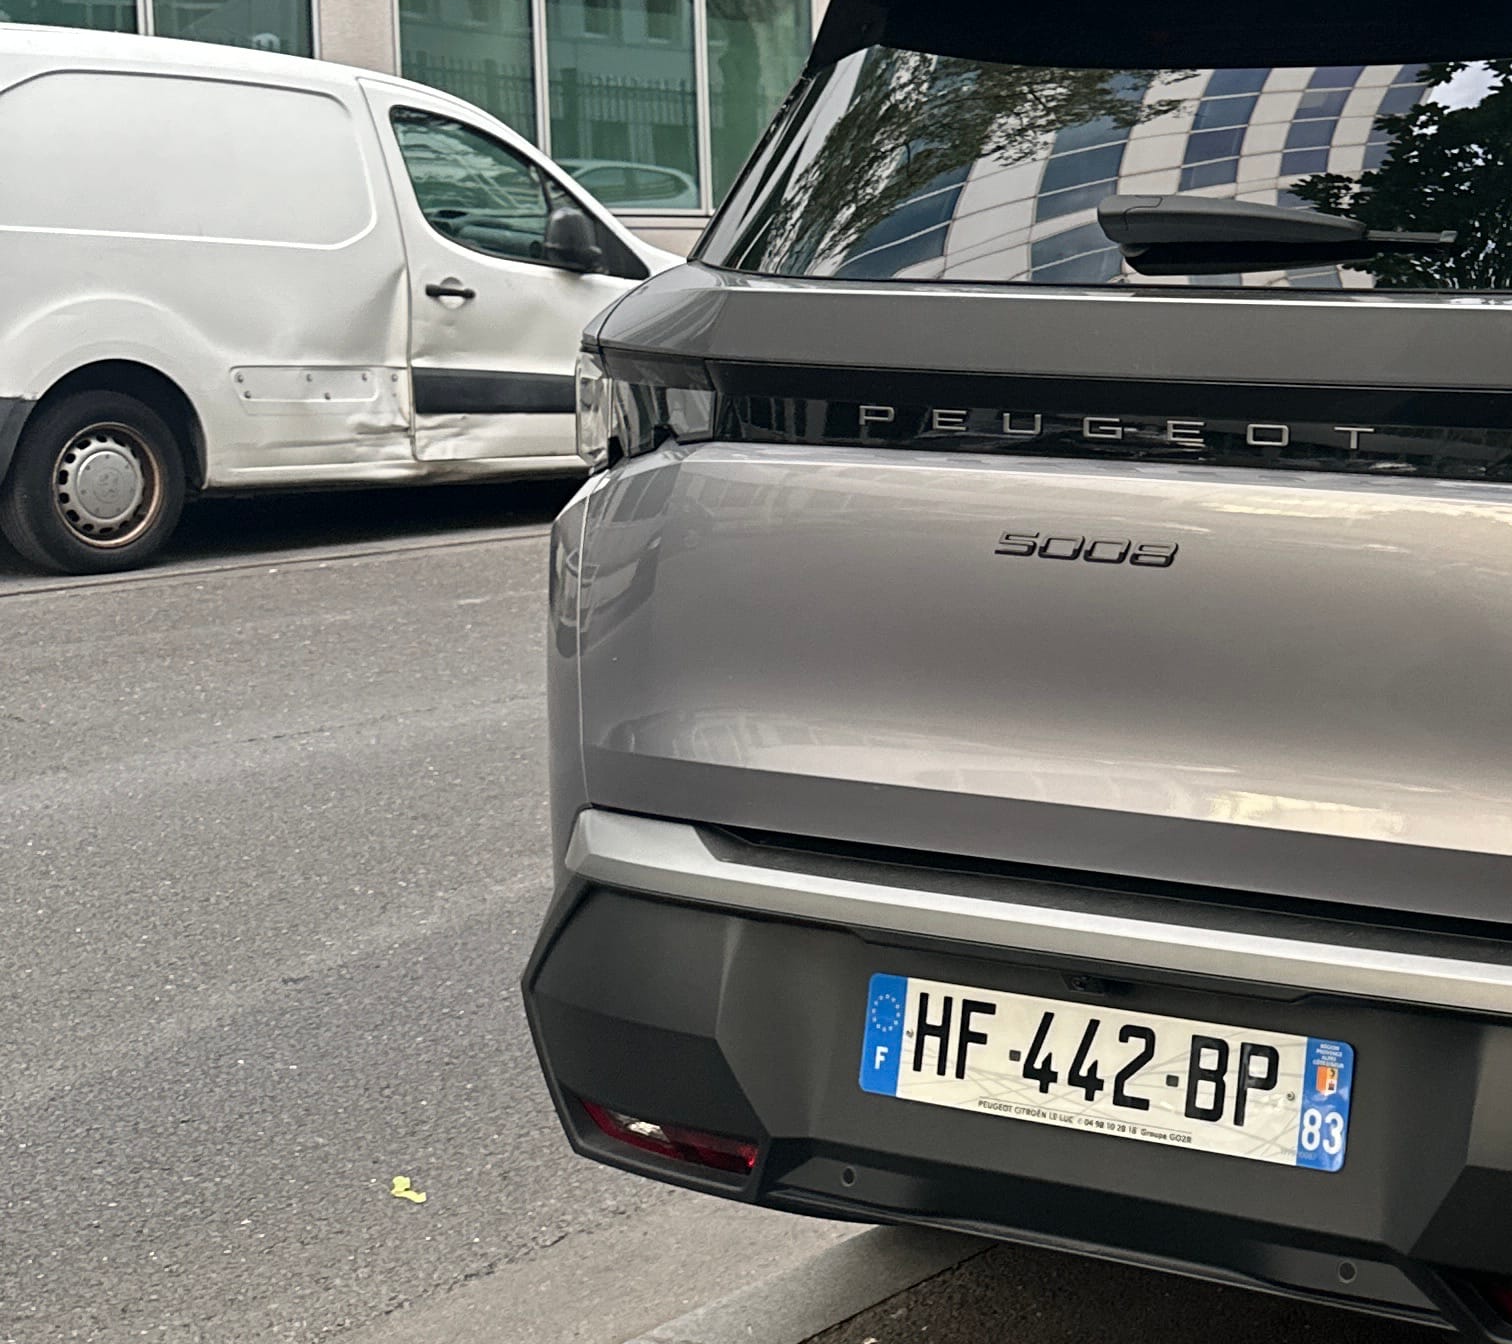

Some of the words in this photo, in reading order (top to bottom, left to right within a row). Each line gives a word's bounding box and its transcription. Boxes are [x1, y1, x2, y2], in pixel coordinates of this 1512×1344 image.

[858, 404, 1375, 450] PEUGEOT
[994, 530, 1180, 568] 5008
[873, 1046, 889, 1070] F
[912, 992, 1280, 1126] HF-442-BP
[977, 1100, 1013, 1113] PEUGEOT
[1301, 1107, 1345, 1155] 83
